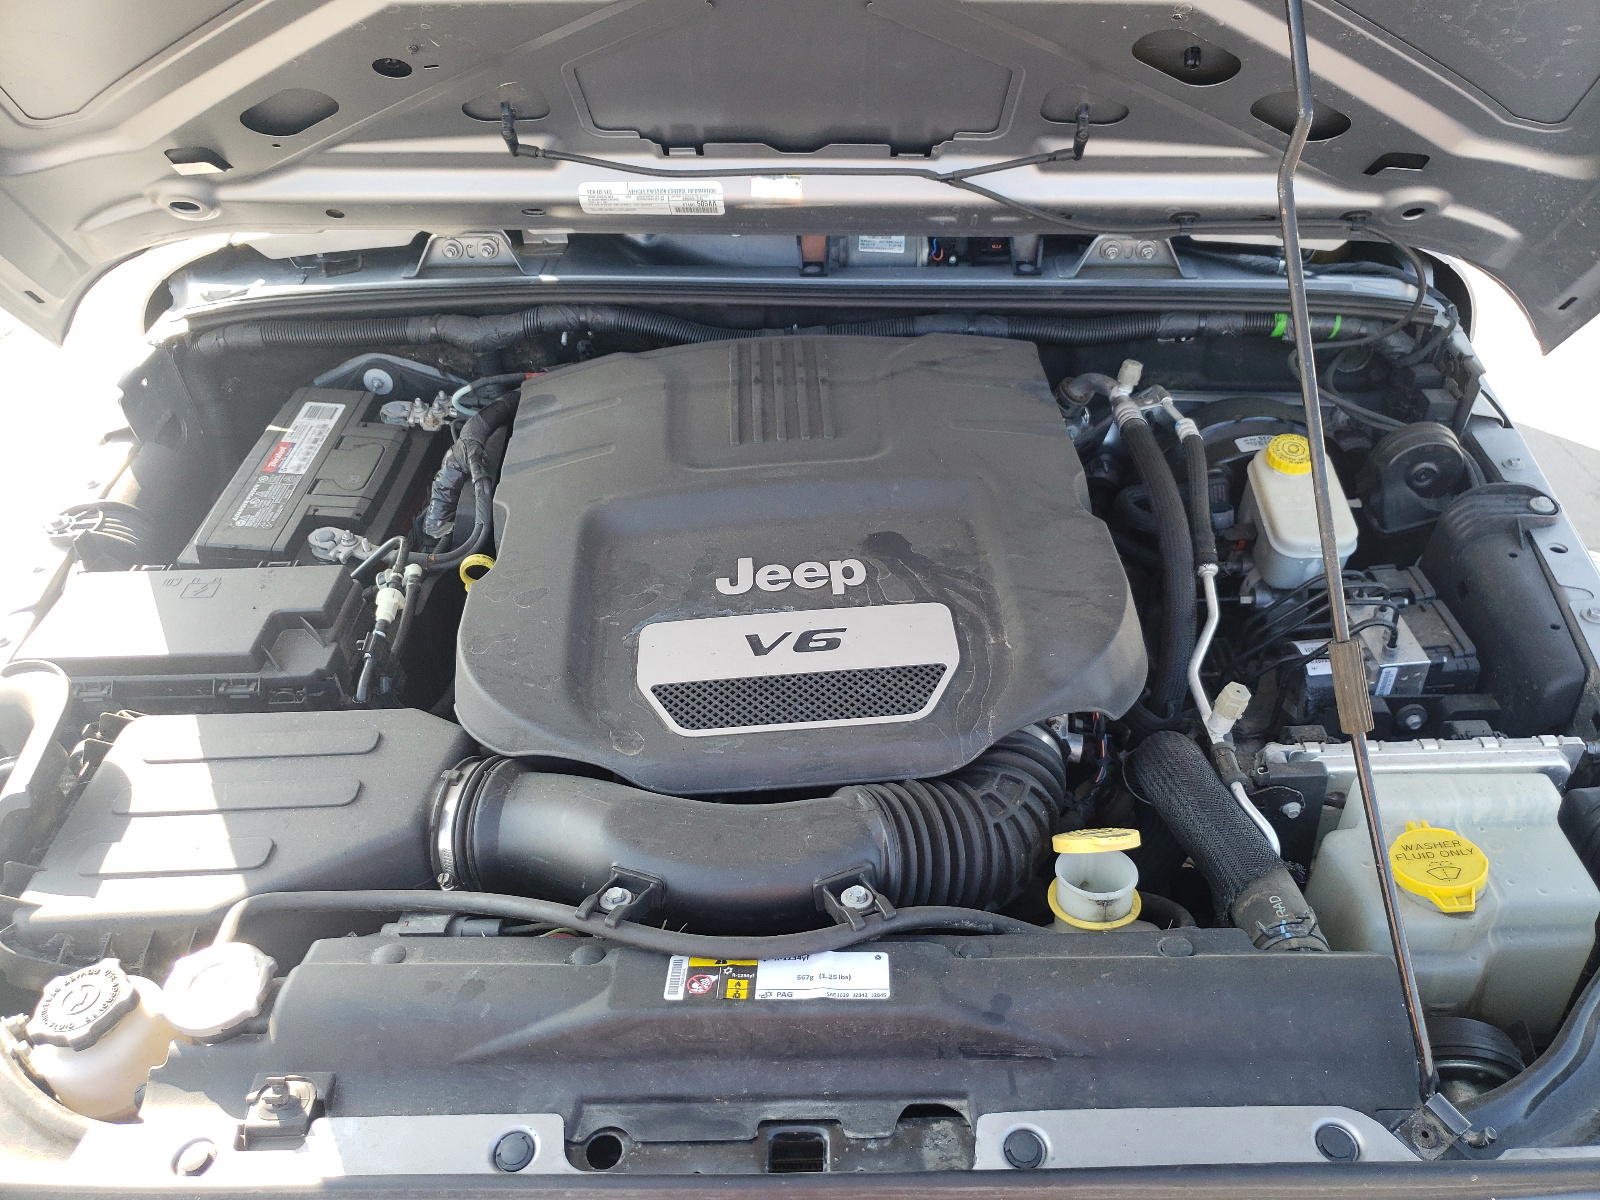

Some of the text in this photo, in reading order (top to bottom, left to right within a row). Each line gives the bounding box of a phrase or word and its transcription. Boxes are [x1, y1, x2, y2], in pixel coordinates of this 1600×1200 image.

[715, 557, 867, 595] Jeep
[745, 627, 847, 657] V6
[1395, 847, 1474, 861] FLUID ONLY
[1401, 840, 1462, 852] WASHER
[1269, 895, 1289, 918] RAD
